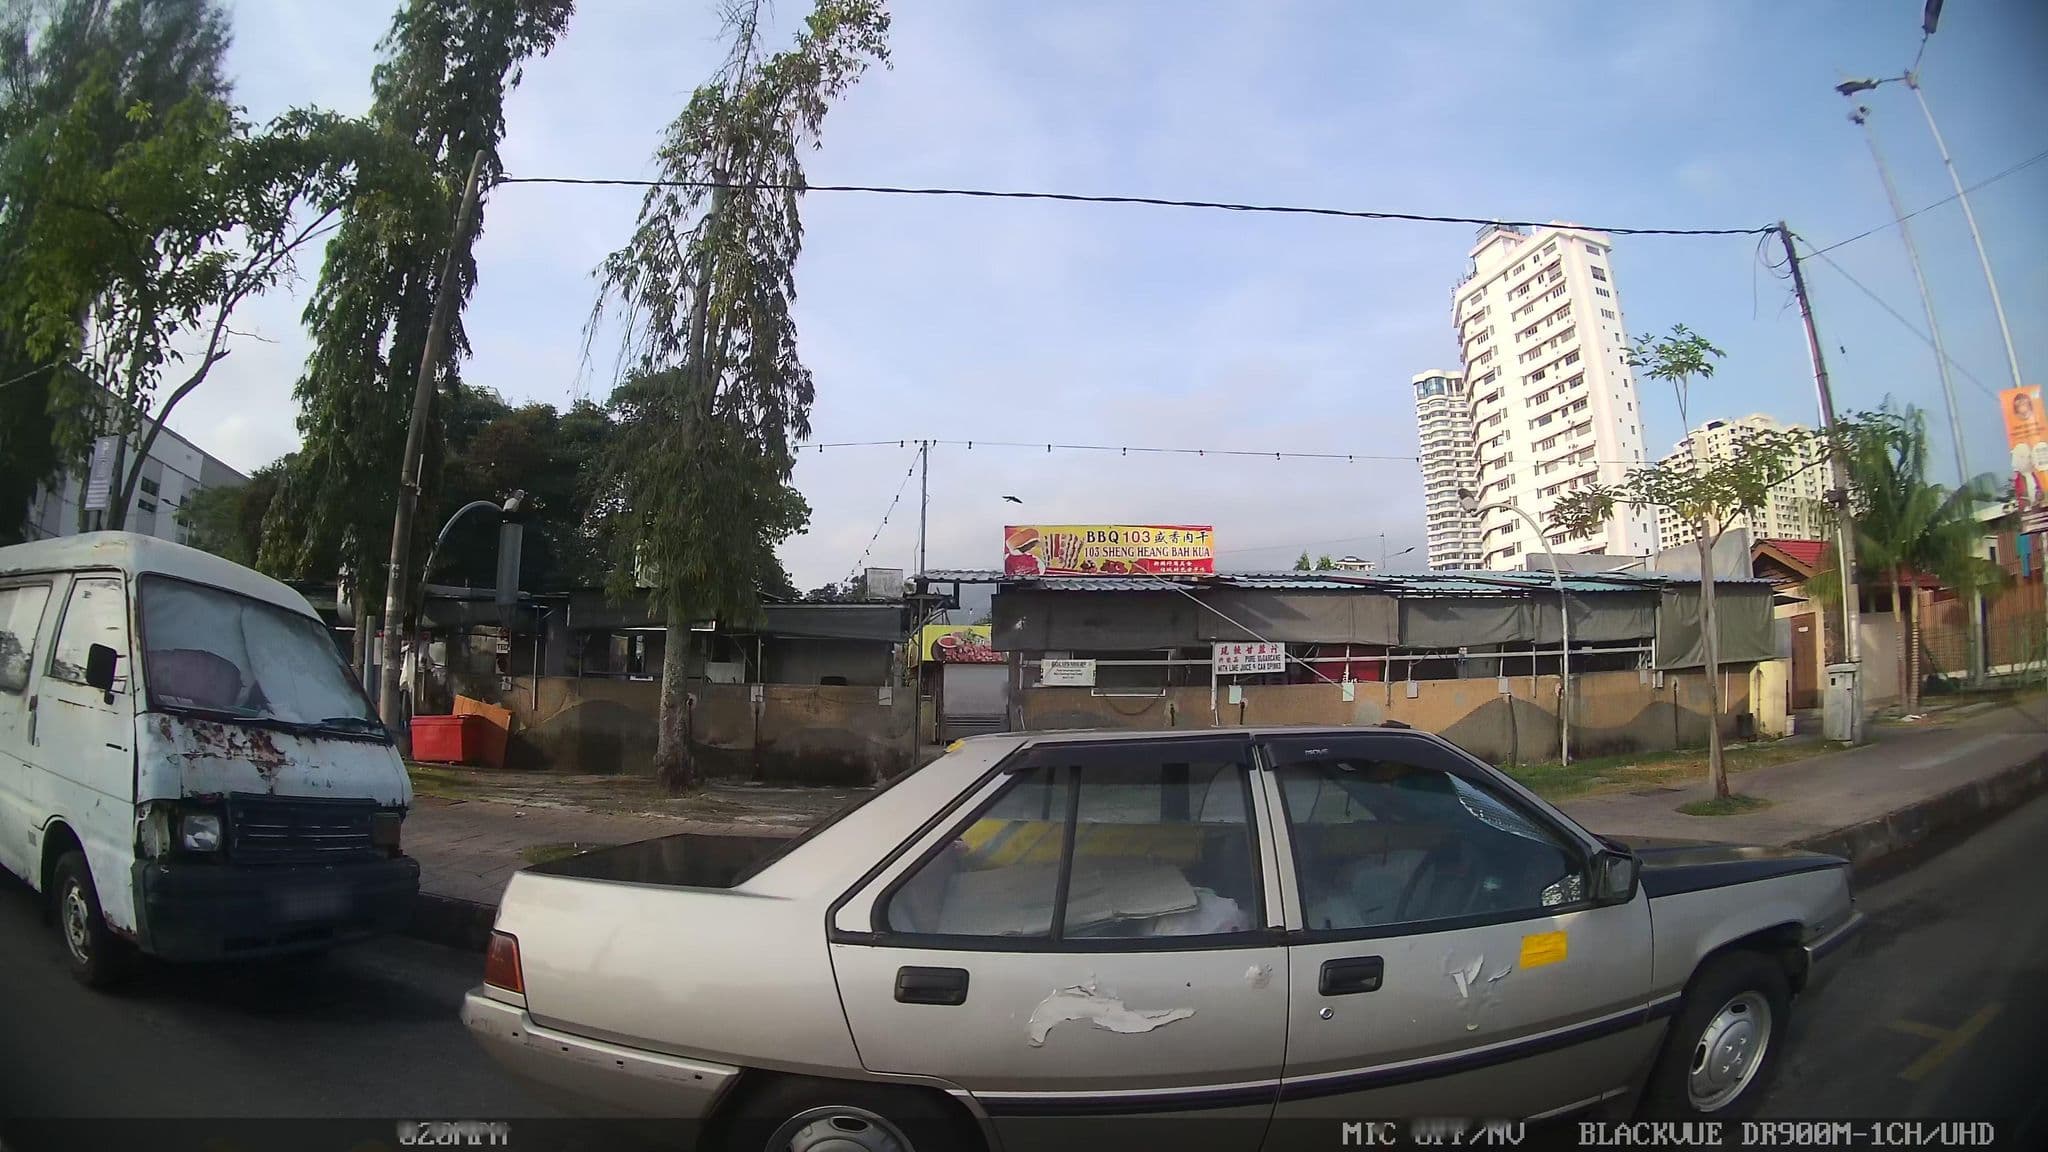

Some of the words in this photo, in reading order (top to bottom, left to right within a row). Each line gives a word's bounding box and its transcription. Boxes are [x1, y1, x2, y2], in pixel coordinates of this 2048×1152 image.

[1086, 531, 1119, 544] BBQ
[1123, 531, 1150, 543] 103
[1085, 547, 1100, 557] 103
[1103, 547, 1135, 557] SHENG
[1138, 547, 1169, 557] HEANG
[1171, 547, 1190, 557] BAH
[1192, 547, 1210, 557] KUA
[1218, 664, 1228, 672] WITH
[1240, 663, 1252, 671] JUICE
